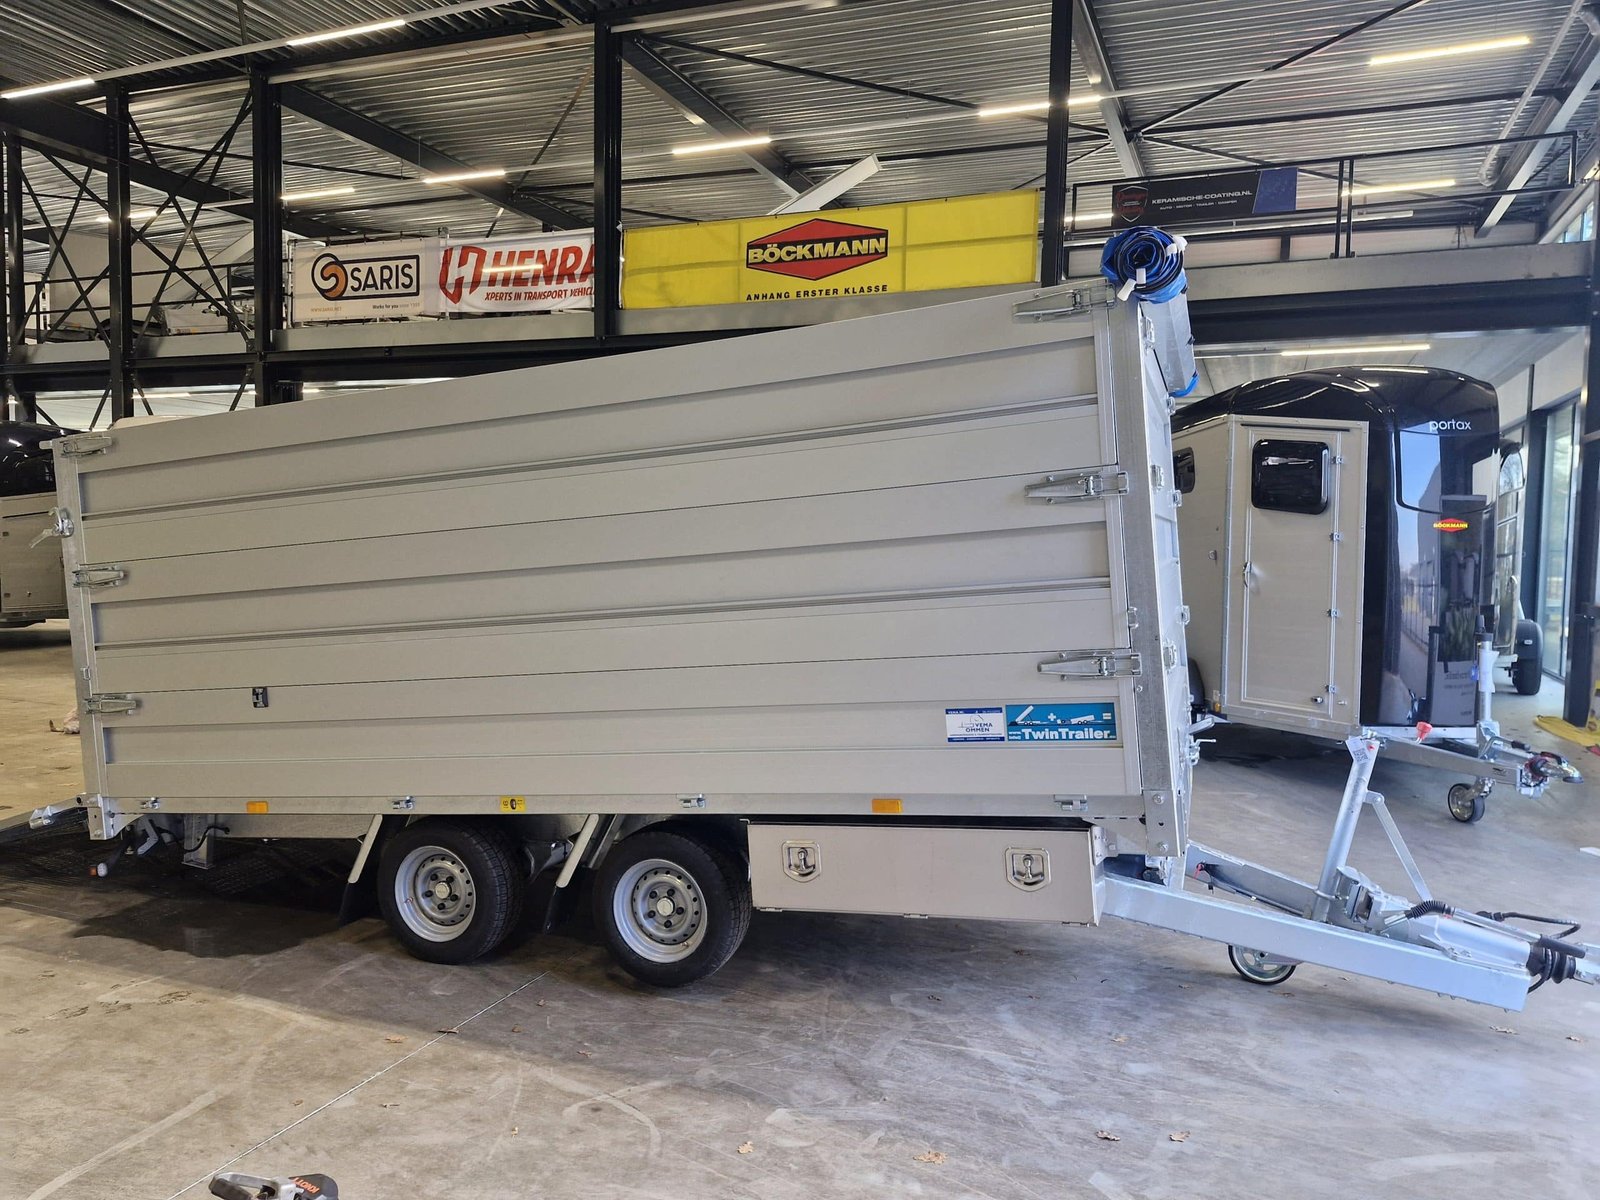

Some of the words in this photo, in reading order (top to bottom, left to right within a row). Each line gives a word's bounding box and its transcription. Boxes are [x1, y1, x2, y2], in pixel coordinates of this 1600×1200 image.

[1152, 190, 1253, 205] KERAMISCHE-COATING.NL
[748, 237, 887, 264] BÖCKMANN
[487, 244, 595, 287] HENRA
[350, 263, 414, 293] SARIS
[485, 292, 513, 301] XPERTS
[513, 292, 522, 301] IN
[524, 289, 568, 300] TRANSPORT
[746, 292, 791, 301] ANHANG
[796, 288, 839, 298] ERSTER
[844, 284, 889, 294] KLASSE
[1429, 418, 1471, 433] portax
[1433, 521, 1468, 529] BÖCKMANN
[1021, 728, 1110, 740] TwinTrailer
